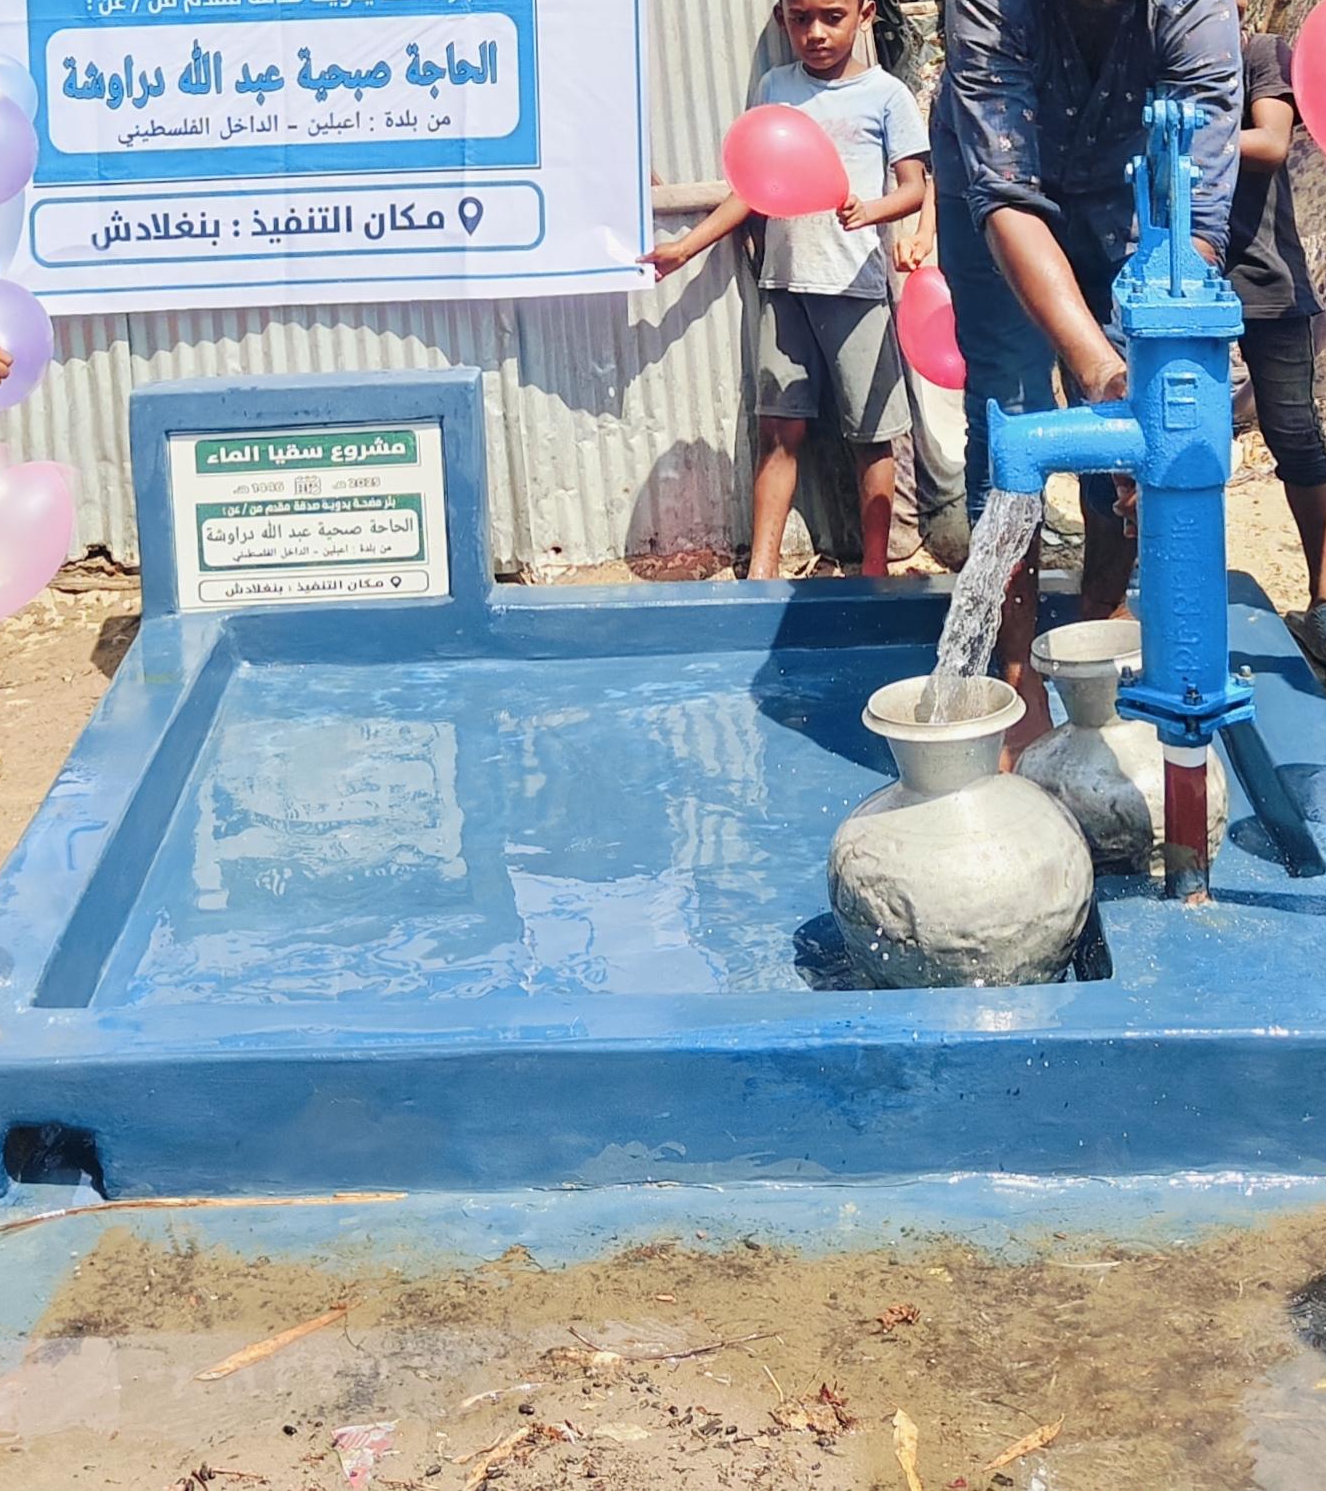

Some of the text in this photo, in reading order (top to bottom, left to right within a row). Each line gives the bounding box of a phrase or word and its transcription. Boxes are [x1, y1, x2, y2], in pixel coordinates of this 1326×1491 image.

[62, 38, 498, 109] الحاجة صبحية عبد الله دراوشة
[117, 117, 210, 147] الفلسطيني
[219, 114, 278, 140] الداخل
[308, 111, 360, 137] اعبلين
[384, 109, 418, 132] بلدة
[427, 113, 451, 132] من
[91, 210, 221, 251] بنغلادش
[251, 205, 353, 244] التنفيذ
[364, 203, 445, 240] مكان
[207, 437, 406, 464] مشروع سقيا الماء
[206, 526, 254, 545] دراوشة
[261, 520, 282, 539] الله
[288, 527, 311, 542] عبد
[297, 580, 343, 593] التنفيذ
